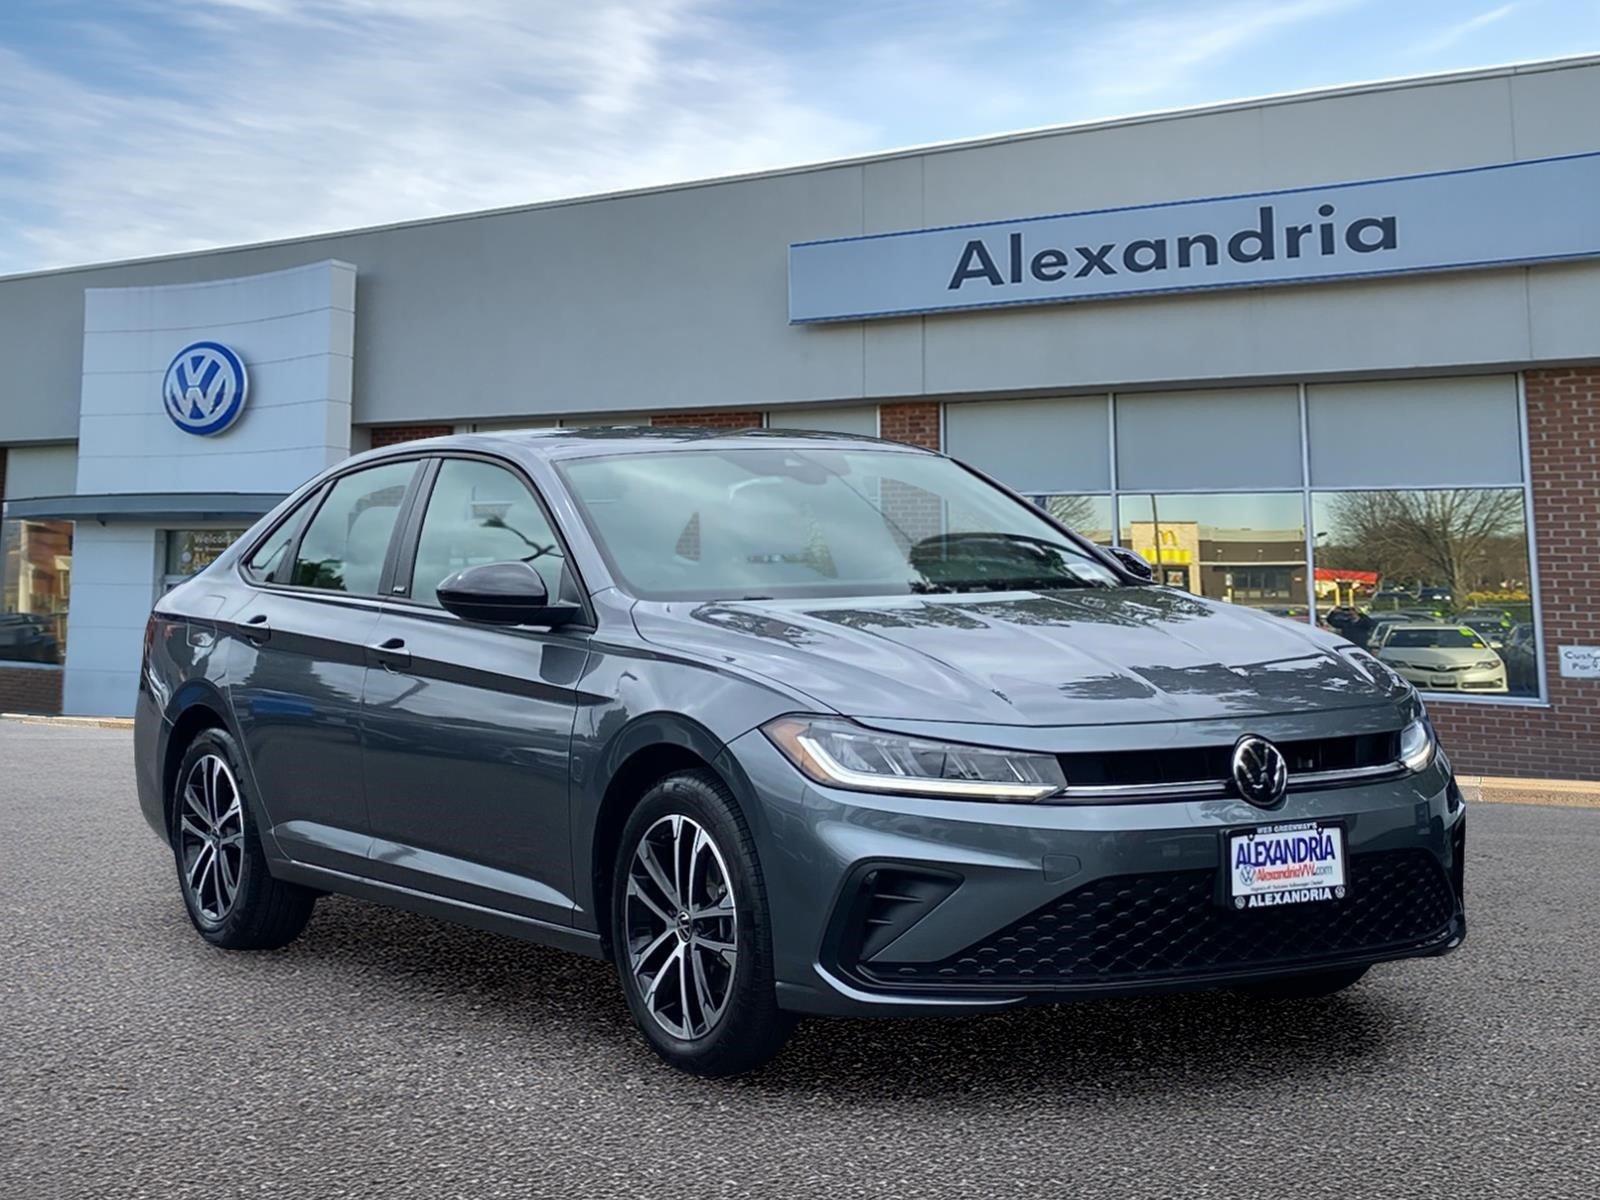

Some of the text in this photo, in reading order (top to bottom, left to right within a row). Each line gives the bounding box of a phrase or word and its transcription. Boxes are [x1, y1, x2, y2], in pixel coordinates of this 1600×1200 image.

[948, 204, 1398, 290] Alexandria
[1235, 834, 1336, 870] ALEXANDRIA
[1248, 887, 1332, 908] ALEXANDRIA
